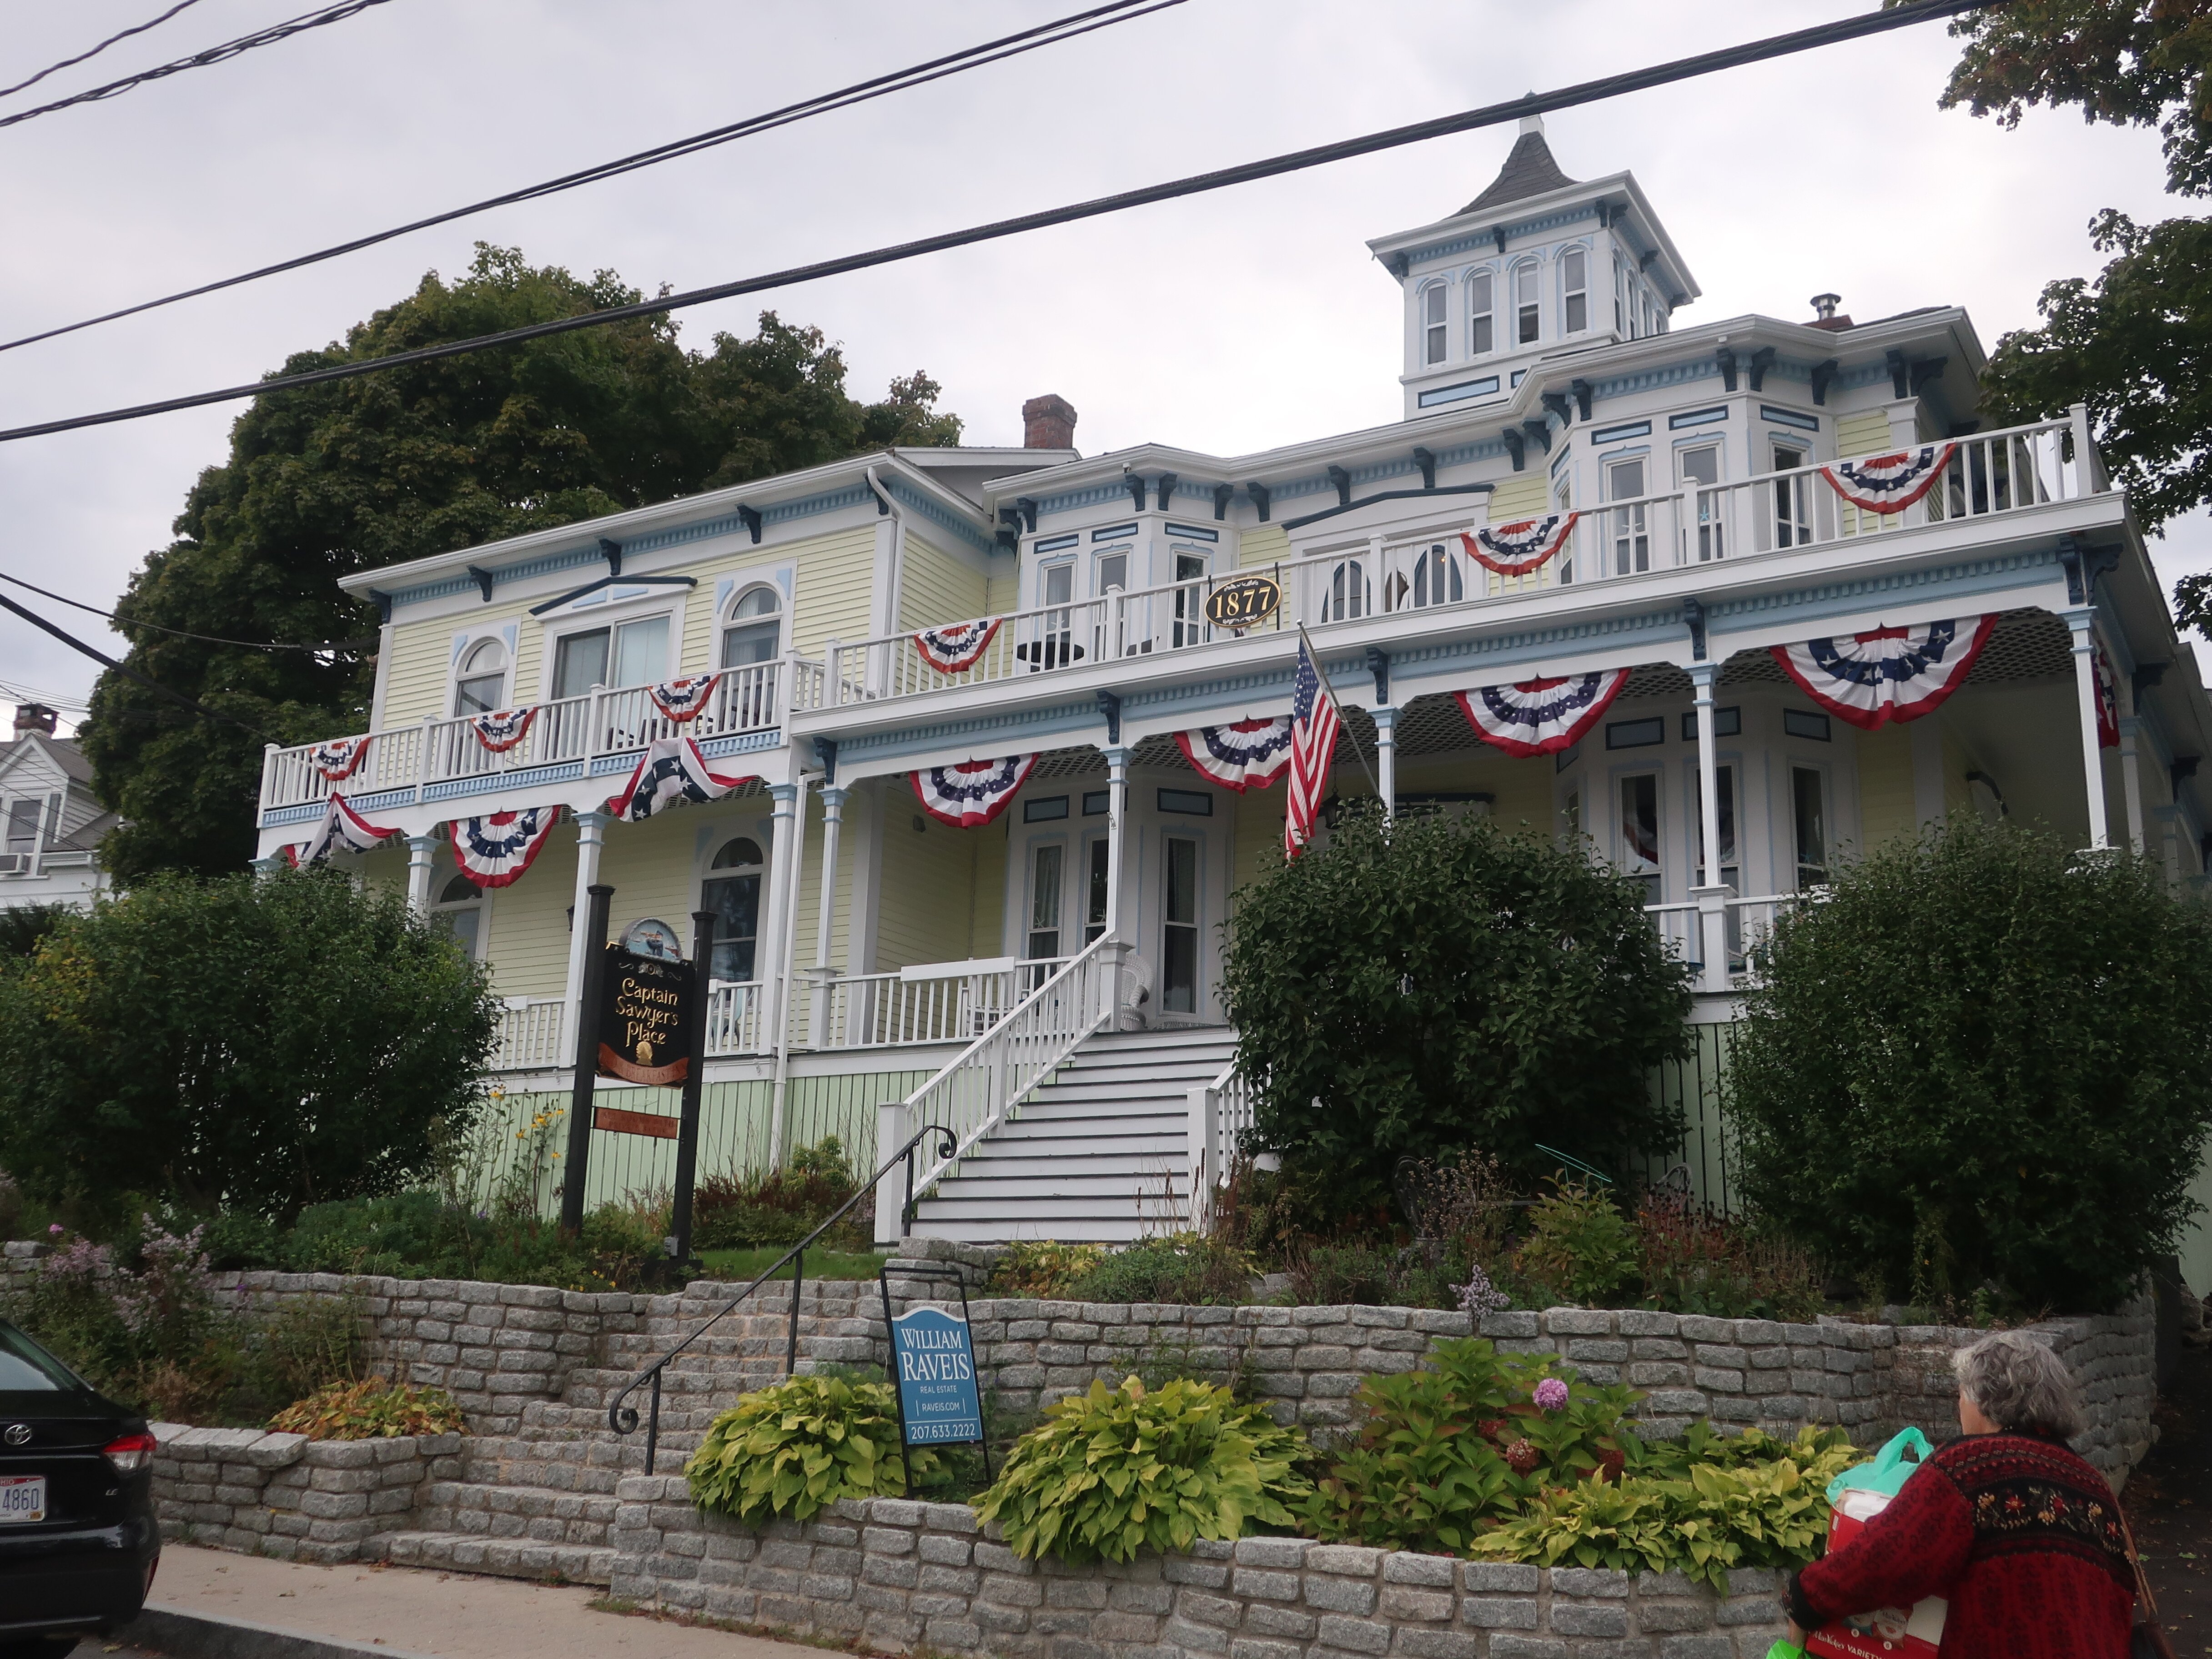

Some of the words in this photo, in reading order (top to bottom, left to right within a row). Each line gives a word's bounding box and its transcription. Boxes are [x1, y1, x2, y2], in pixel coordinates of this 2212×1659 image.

[1215, 586, 1271, 618] 1877
[622, 978, 678, 1005] Captain
[616, 996, 678, 1028] Sawyer's
[625, 1021, 666, 1047] Place
[900, 1328, 963, 1349] WILLIAM
[900, 1352, 970, 1381] RAVEIS
[936, 1385, 957, 1393] ESTATE
[922, 1402, 960, 1412] RAVEIS.COM
[911, 1423, 975, 1440] 207.633.2222
[3, 1488, 39, 1510] 4860
